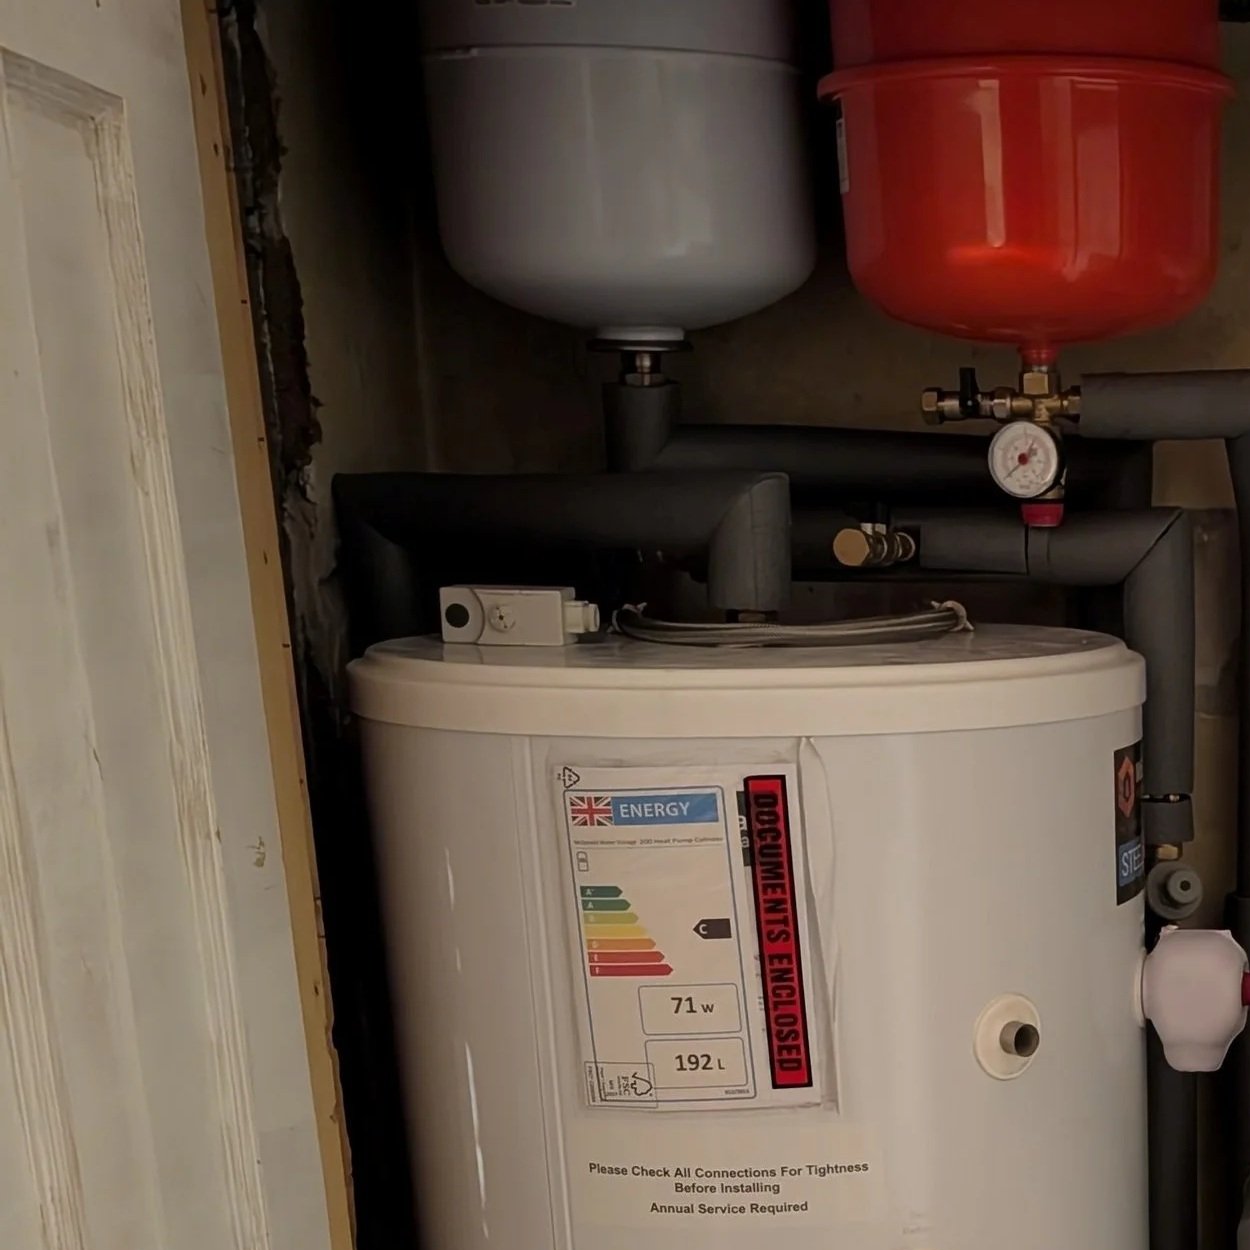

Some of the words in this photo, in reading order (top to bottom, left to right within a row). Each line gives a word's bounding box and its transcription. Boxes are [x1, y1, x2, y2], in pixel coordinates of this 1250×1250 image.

[619, 802, 690, 818] ENERGY
[753, 792, 792, 943] DOCUMENTS
[699, 924, 708, 934] C
[670, 996, 697, 1014] 71
[768, 953, 802, 1072] ENCLOSED
[675, 1054, 713, 1071] 192
[717, 1059, 725, 1070] L
[589, 1163, 628, 1176] Please
[631, 1165, 670, 1178] Check
[674, 1167, 691, 1178] All
[695, 1167, 776, 1178] Connections
[781, 1166, 802, 1177] For
[806, 1162, 869, 1177] Tightness
[675, 1182, 717, 1194] Before
[721, 1182, 780, 1195] Installing
[650, 1202, 694, 1214] Annual
[698, 1203, 746, 1214] Service
[750, 1201, 808, 1216] Required
